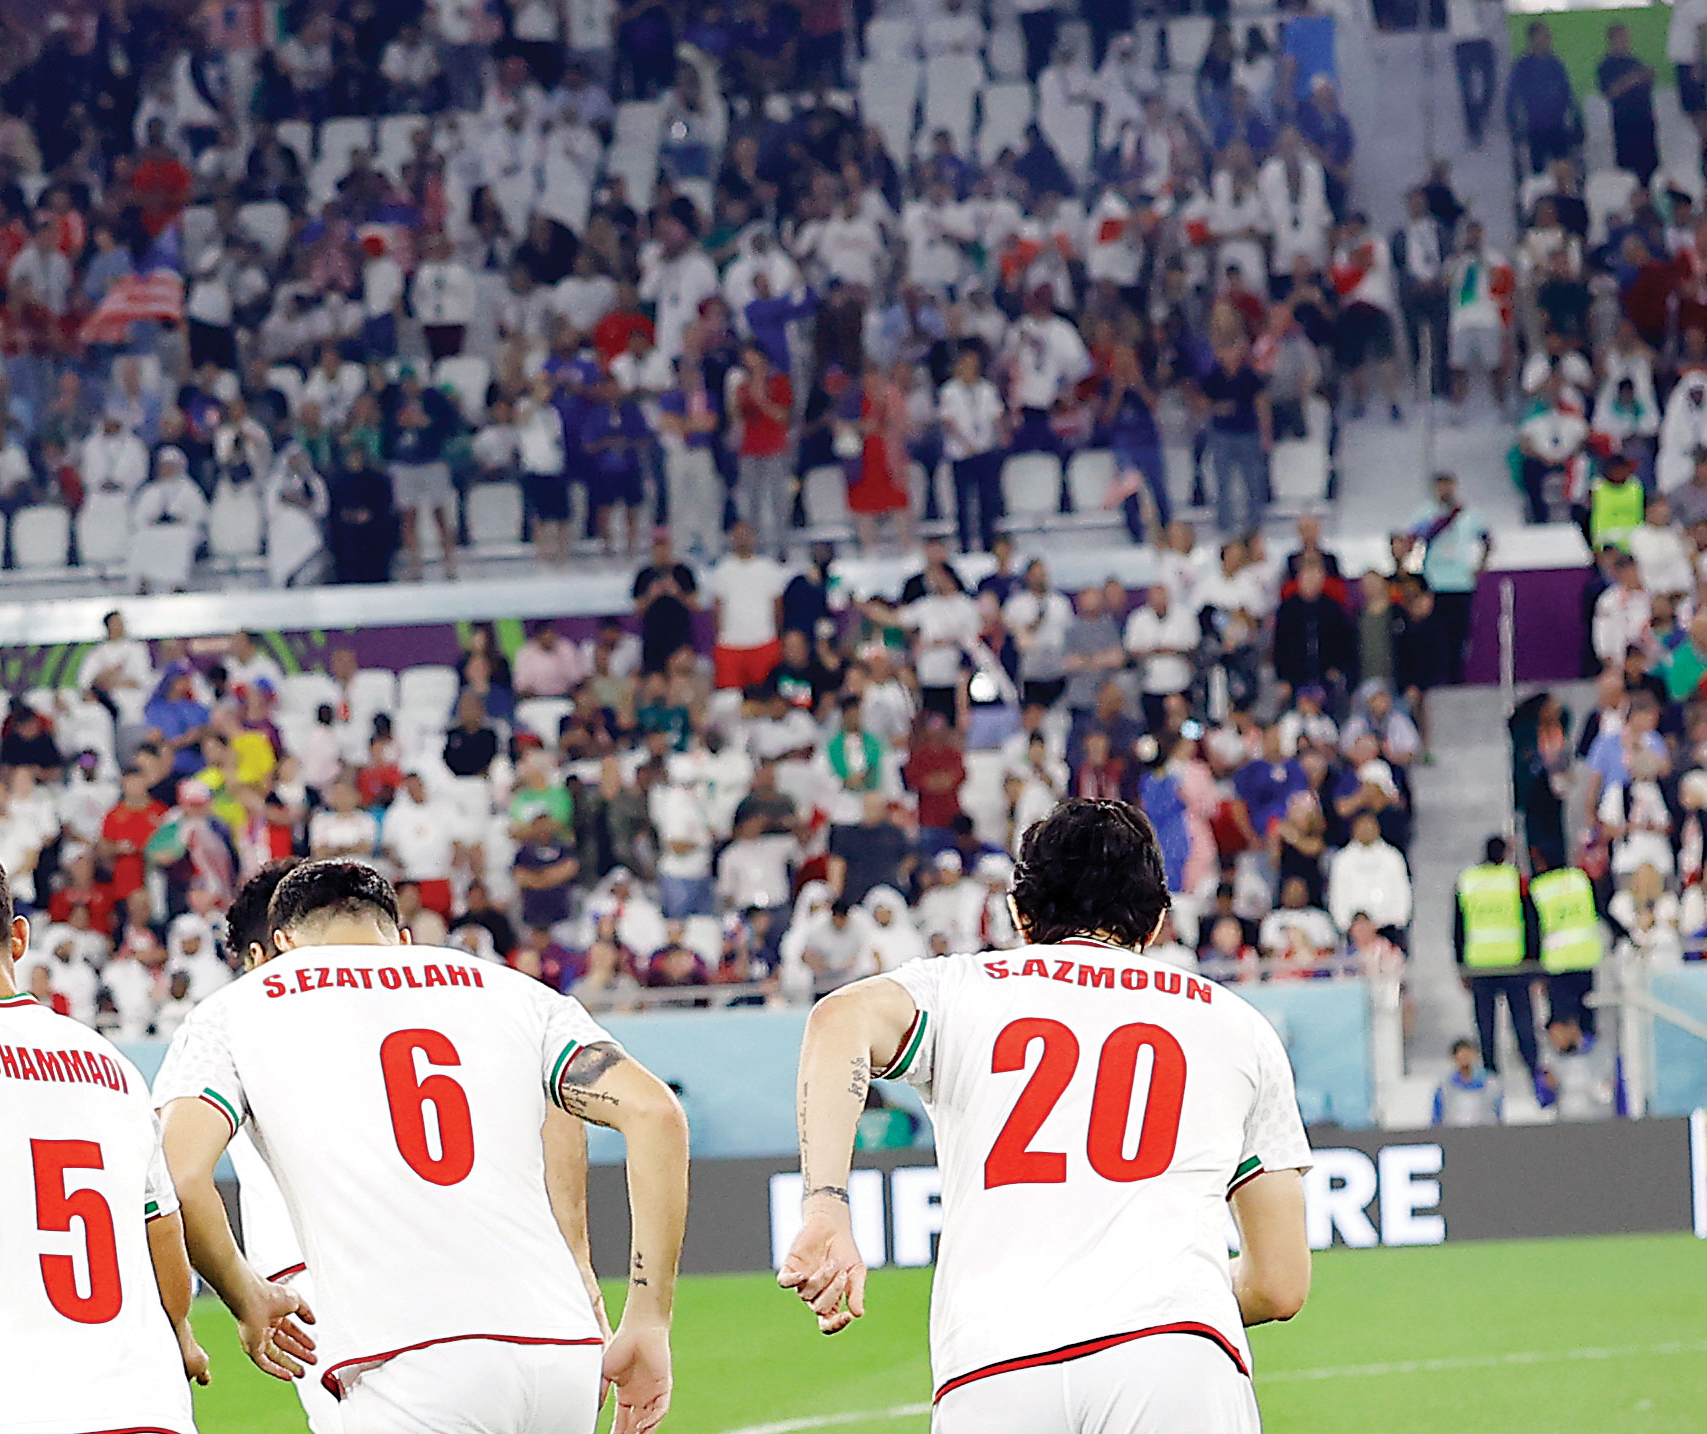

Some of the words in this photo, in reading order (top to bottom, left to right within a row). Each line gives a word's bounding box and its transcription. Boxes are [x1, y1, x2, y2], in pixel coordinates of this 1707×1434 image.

[262, 963, 485, 1000] S.EZATOLAHI
[982, 957, 1213, 1005] S.AZMOUN
[379, 1027, 476, 1188] 6
[983, 1016, 1189, 1191] 20
[29, 1137, 124, 1326] 5
[1303, 1143, 1448, 1250] RE
